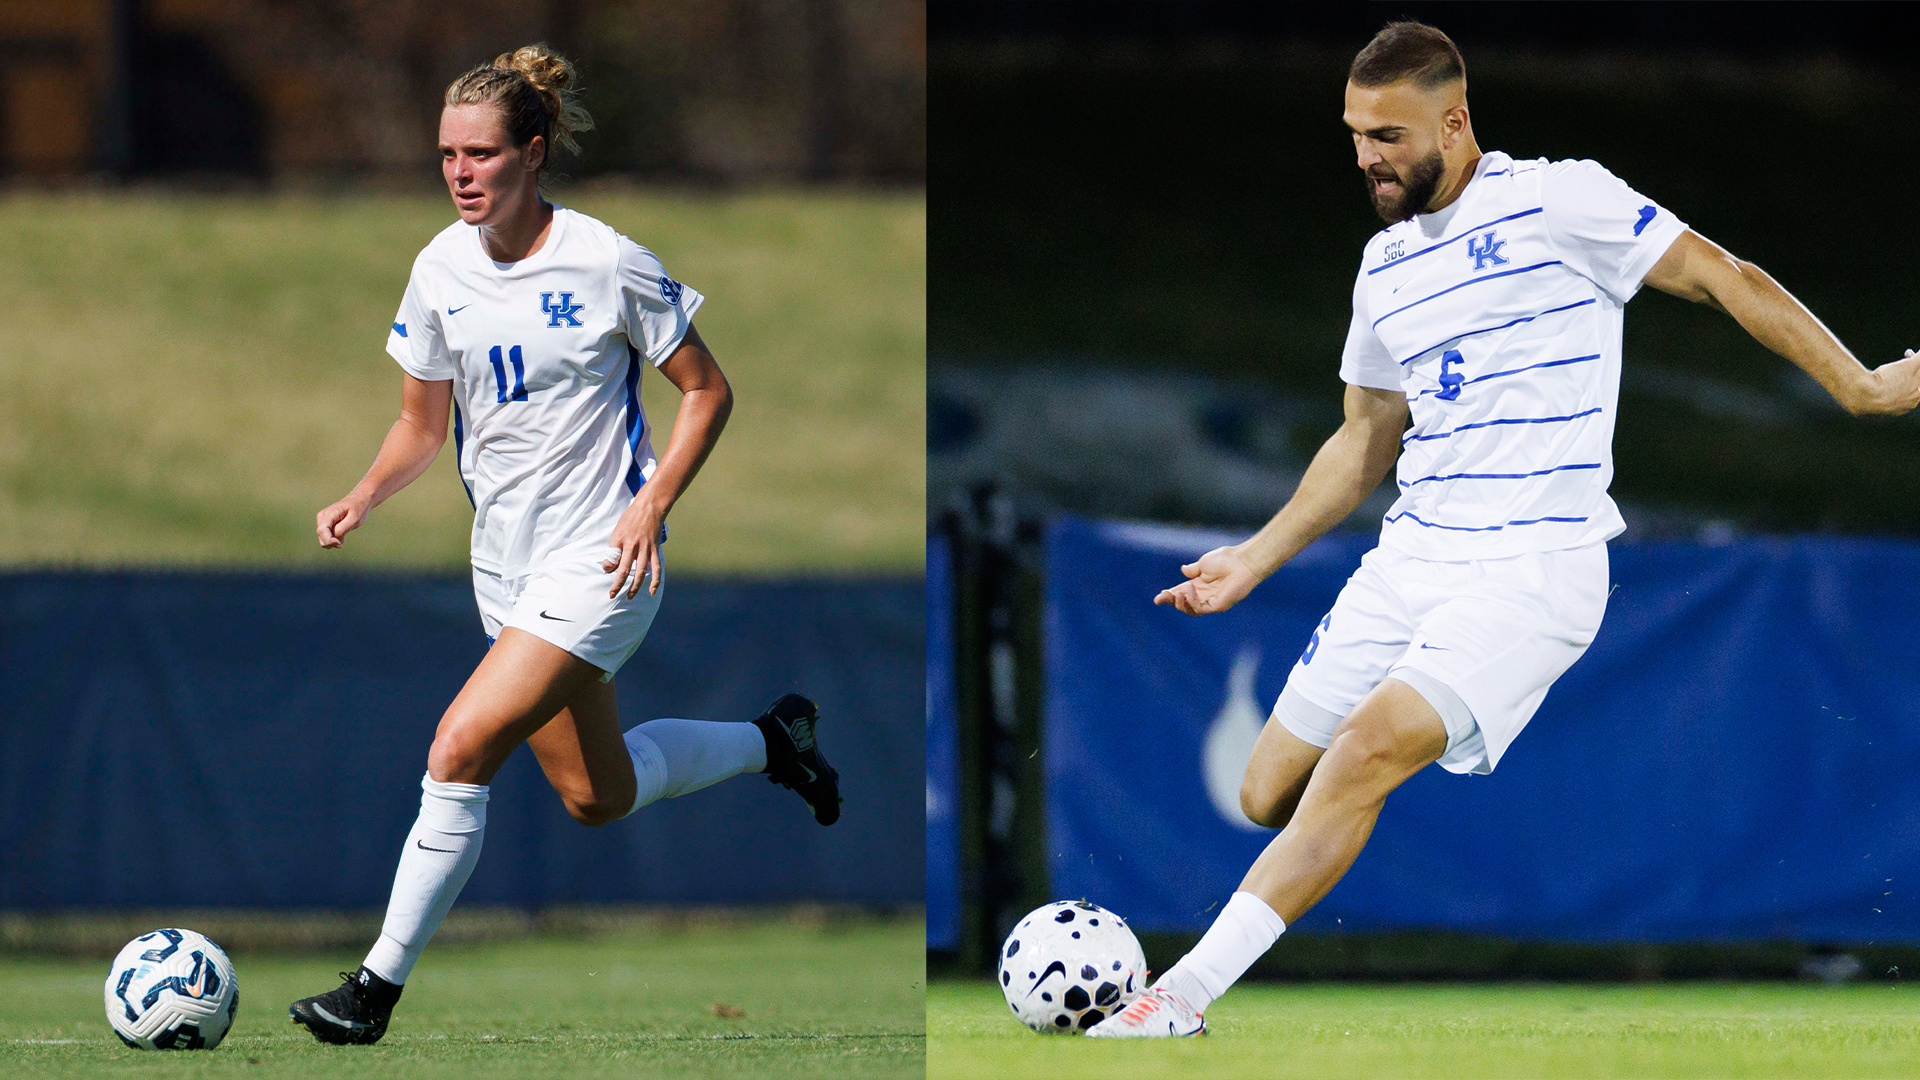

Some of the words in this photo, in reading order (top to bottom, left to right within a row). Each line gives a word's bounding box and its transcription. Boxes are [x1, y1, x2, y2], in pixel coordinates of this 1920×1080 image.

[1467, 230, 1510, 273] UK
[540, 291, 585, 328] UK
[489, 345, 528, 403] 11
[1434, 349, 1465, 401] 6
